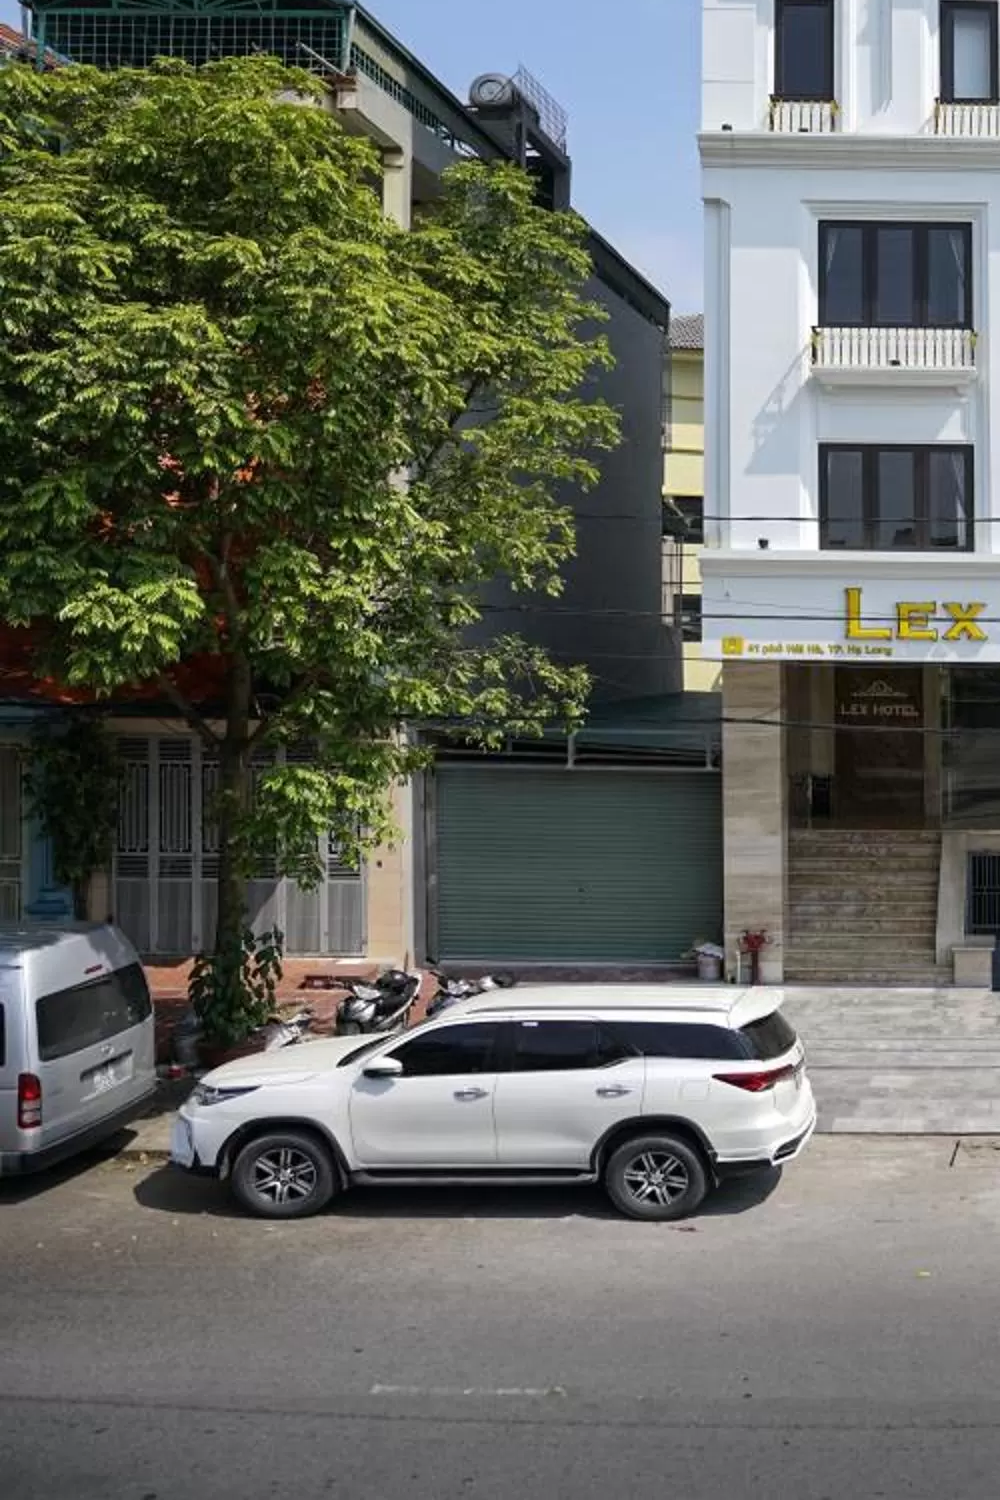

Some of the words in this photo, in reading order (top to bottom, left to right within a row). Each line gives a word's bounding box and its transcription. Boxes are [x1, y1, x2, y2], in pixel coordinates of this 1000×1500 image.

[843, 586, 988, 643] LEX
[841, 703, 868, 716] LEX
[873, 703, 919, 717] HOTEL
